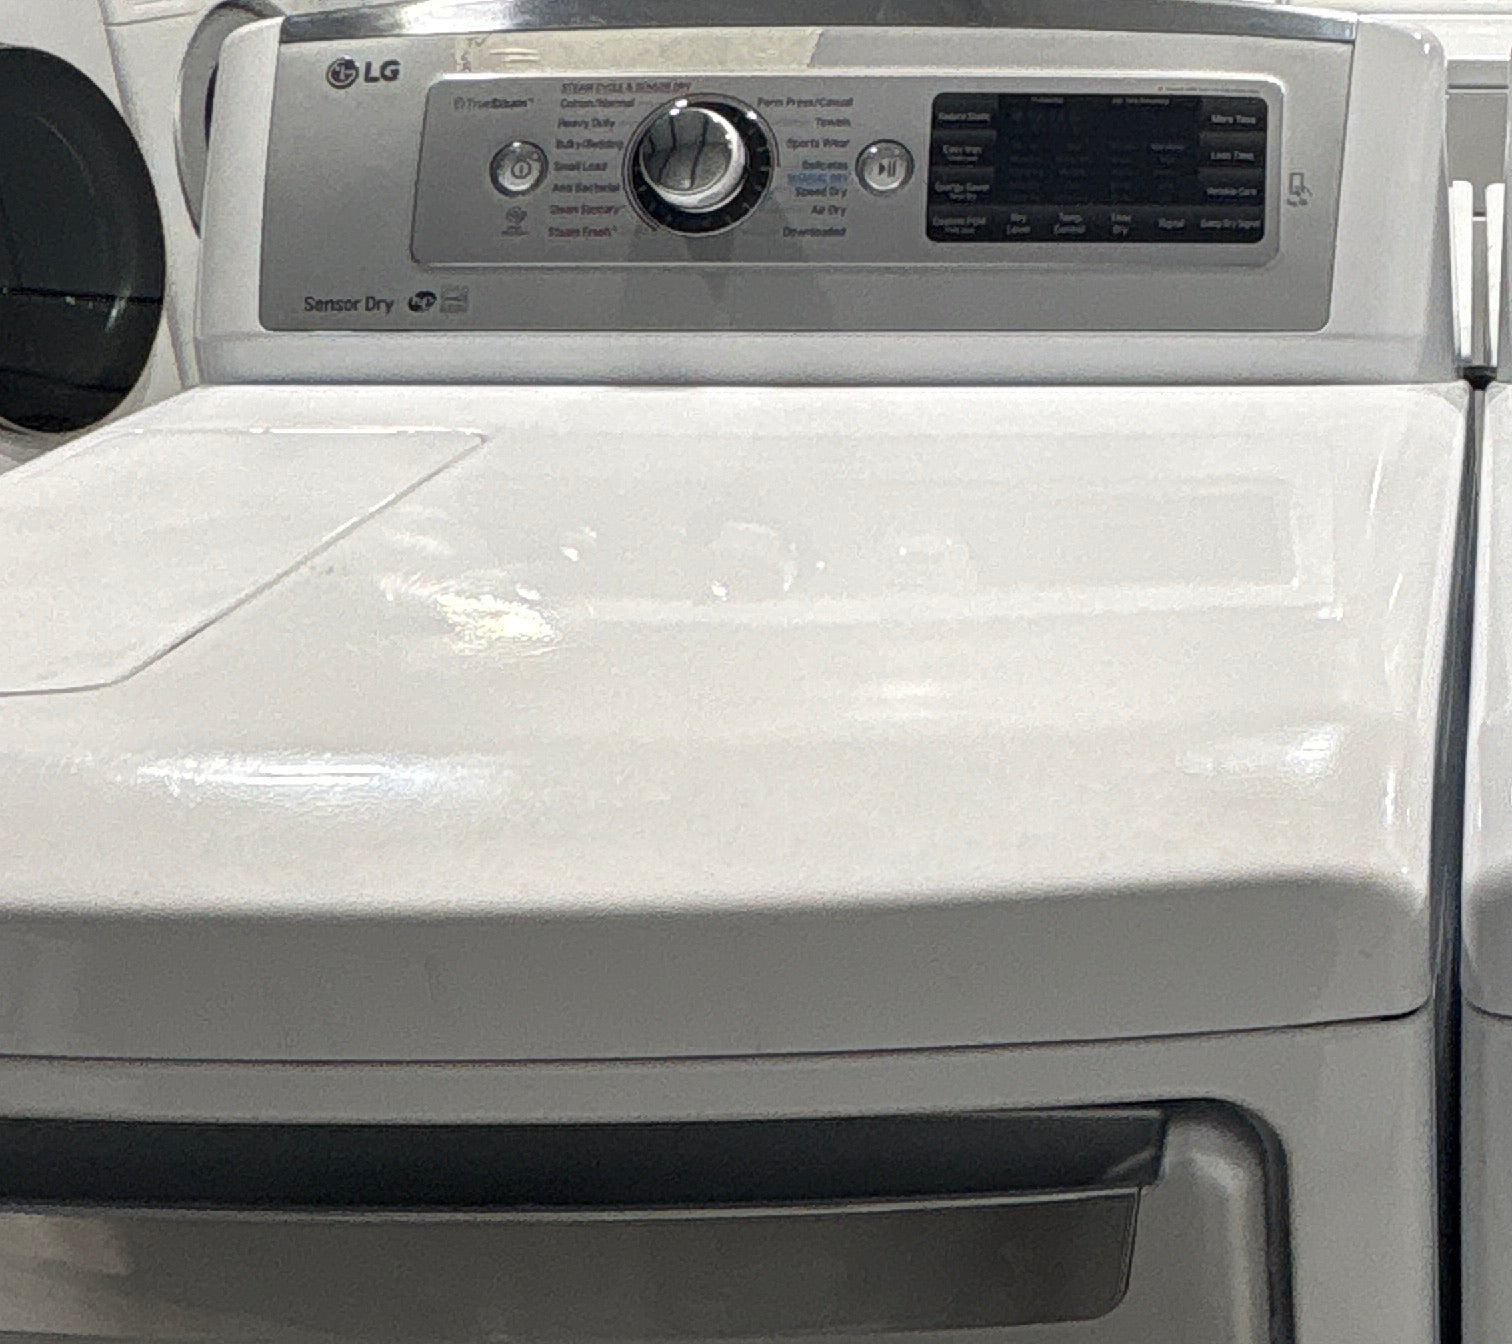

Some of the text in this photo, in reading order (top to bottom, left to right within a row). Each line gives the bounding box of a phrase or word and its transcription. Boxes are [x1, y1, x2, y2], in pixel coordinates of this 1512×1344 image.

[364, 59, 401, 83] LG
[303, 295, 395, 316] Sensor Dry
